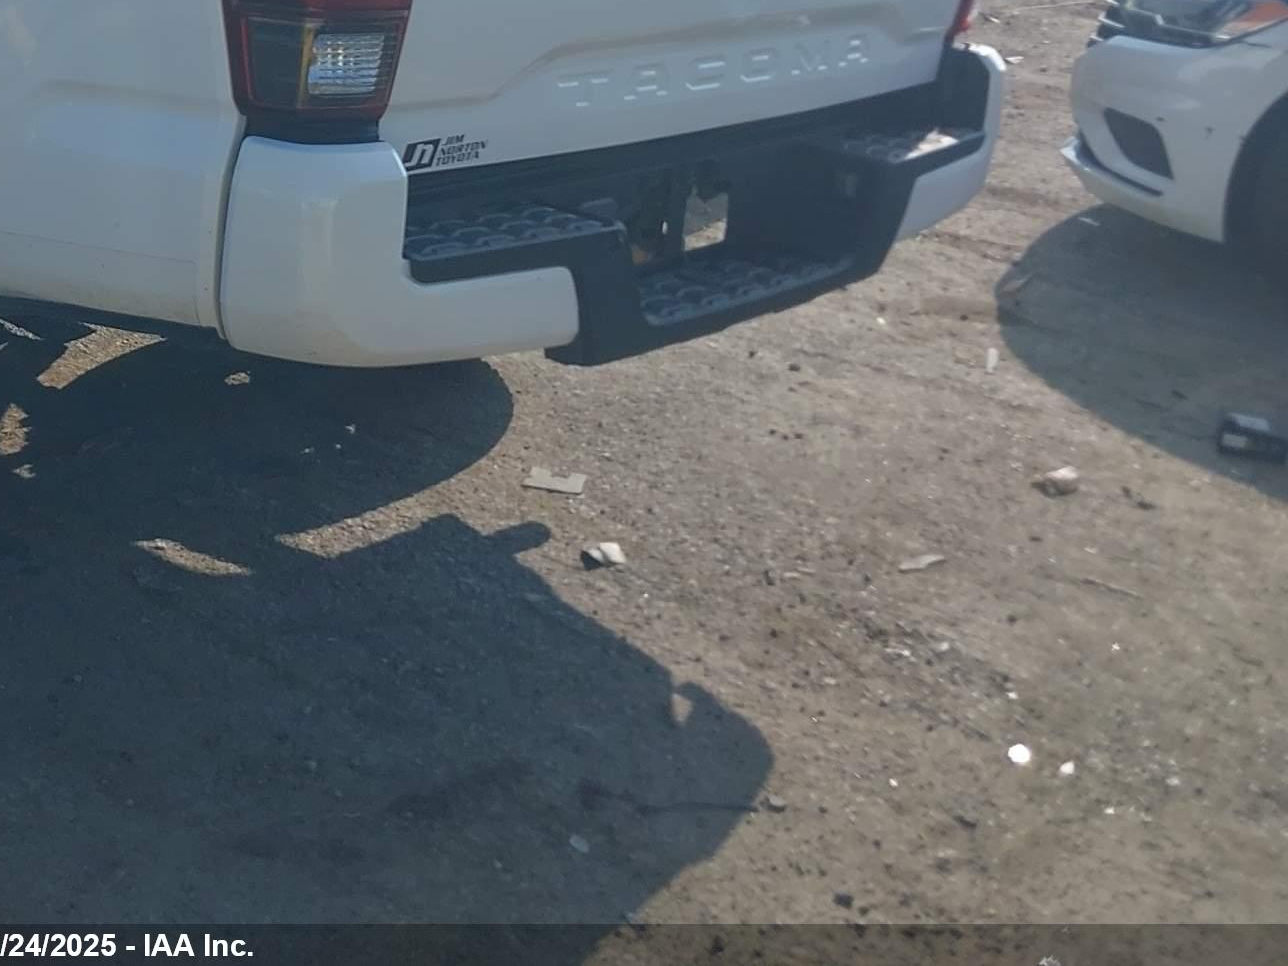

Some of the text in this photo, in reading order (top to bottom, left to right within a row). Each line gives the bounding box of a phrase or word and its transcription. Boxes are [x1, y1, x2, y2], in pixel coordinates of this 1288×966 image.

[557, 34, 871, 107] TACOMA
[439, 140, 488, 156] NORTON
[441, 134, 465, 146] JIM
[435, 150, 480, 167] TOYOTA
